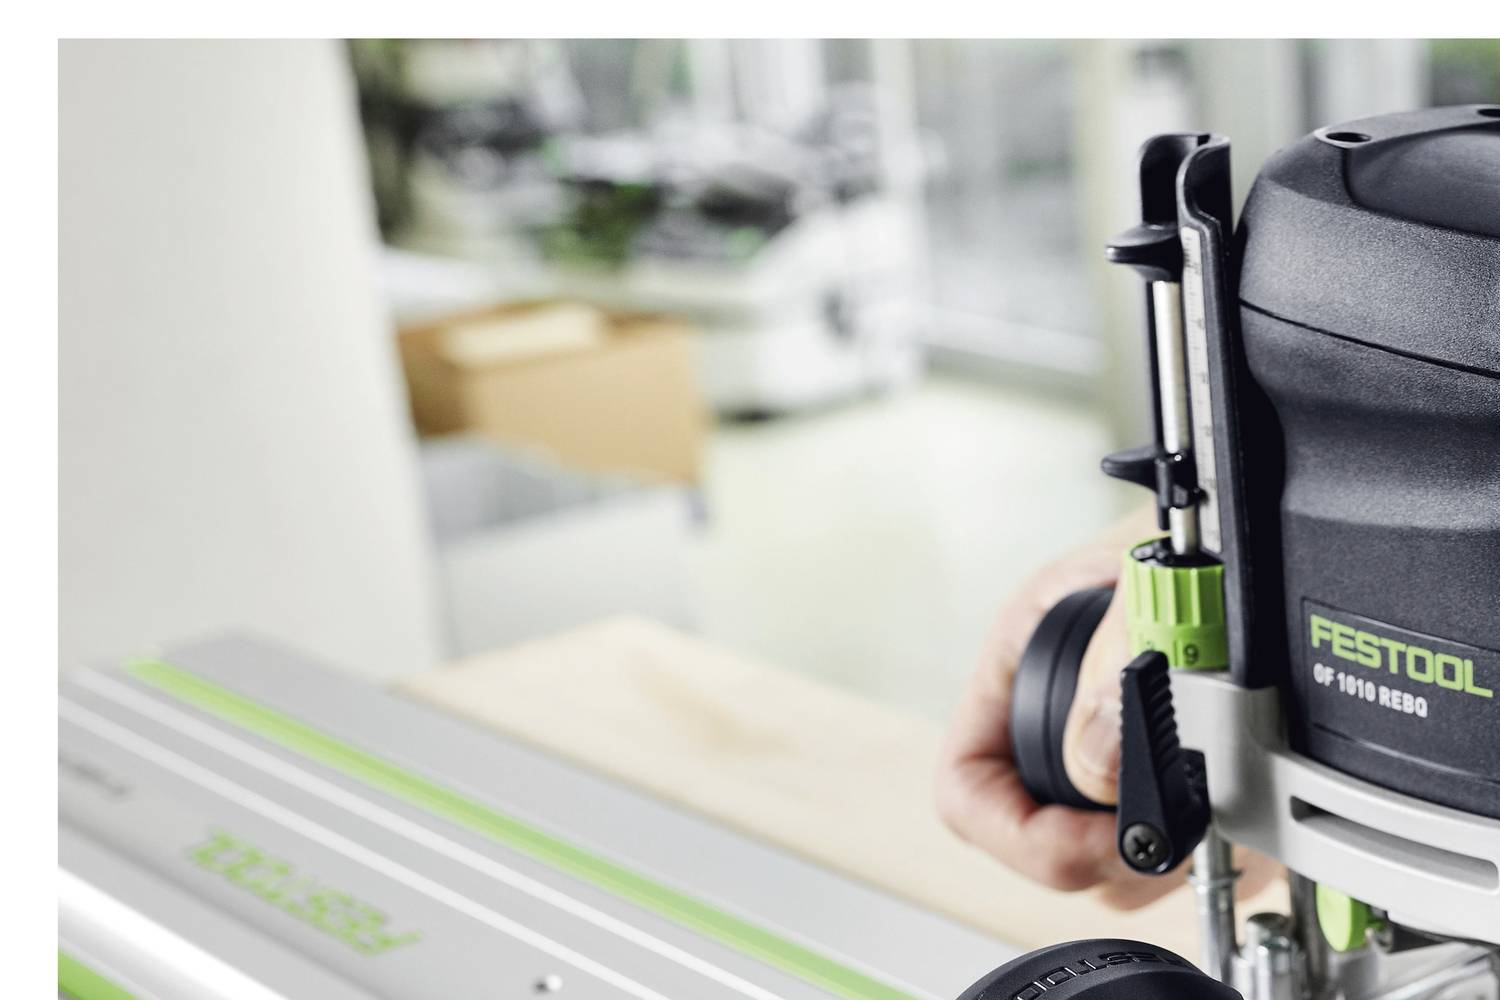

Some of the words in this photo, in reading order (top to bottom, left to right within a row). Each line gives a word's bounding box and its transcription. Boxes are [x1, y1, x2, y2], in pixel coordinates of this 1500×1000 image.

[1310, 614, 1493, 698] FESTOOL
[1313, 662, 1335, 687] OF
[1337, 671, 1376, 702] 1010
[1378, 685, 1428, 718] REBQ
